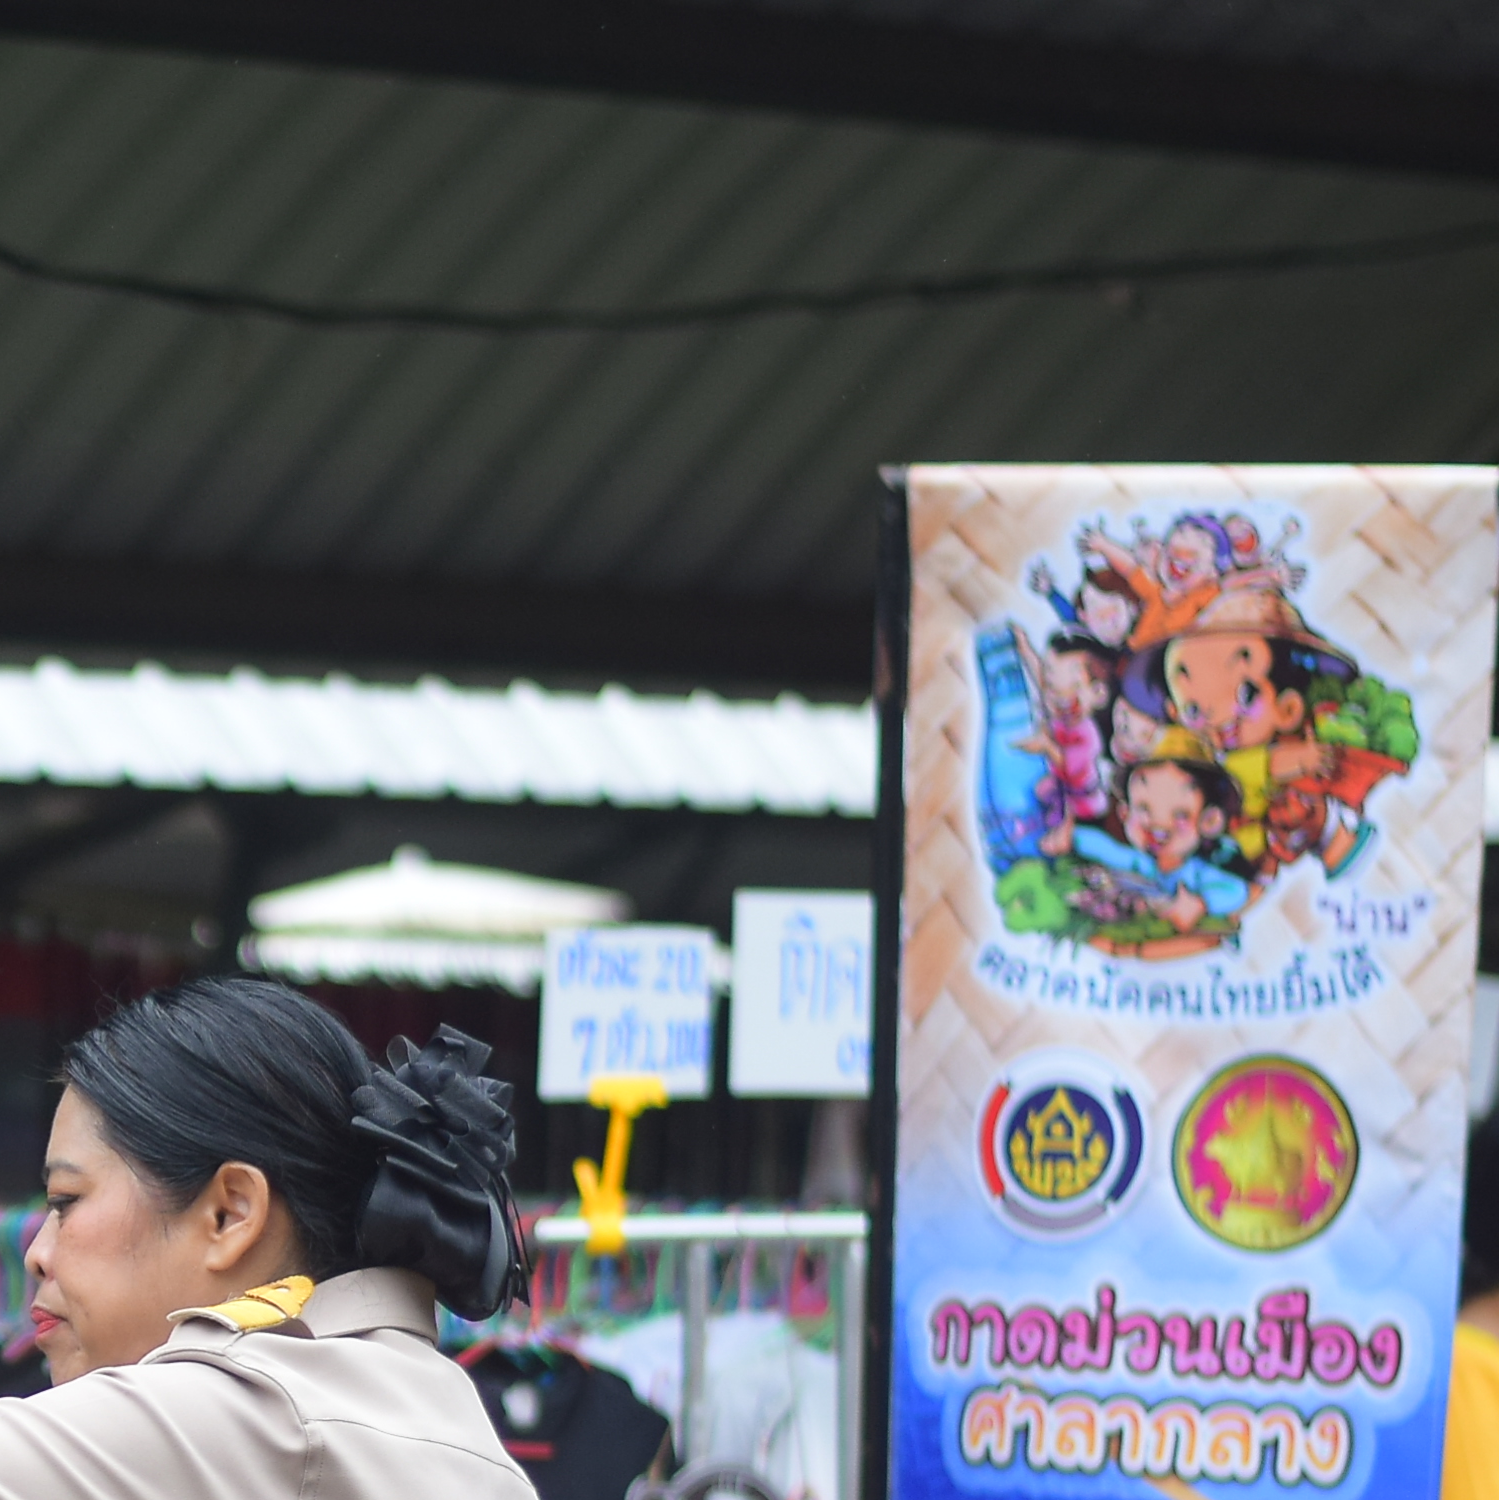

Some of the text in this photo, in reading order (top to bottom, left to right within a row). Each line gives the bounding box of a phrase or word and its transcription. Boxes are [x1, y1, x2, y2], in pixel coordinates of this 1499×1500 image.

[977, 942, 1384, 1019] ตลาดนัดคนไทยยิ้มได้
[933, 1284, 1403, 1386] กาดม่วนเมือง
[960, 1382, 1353, 1487] ศาลากลาง
